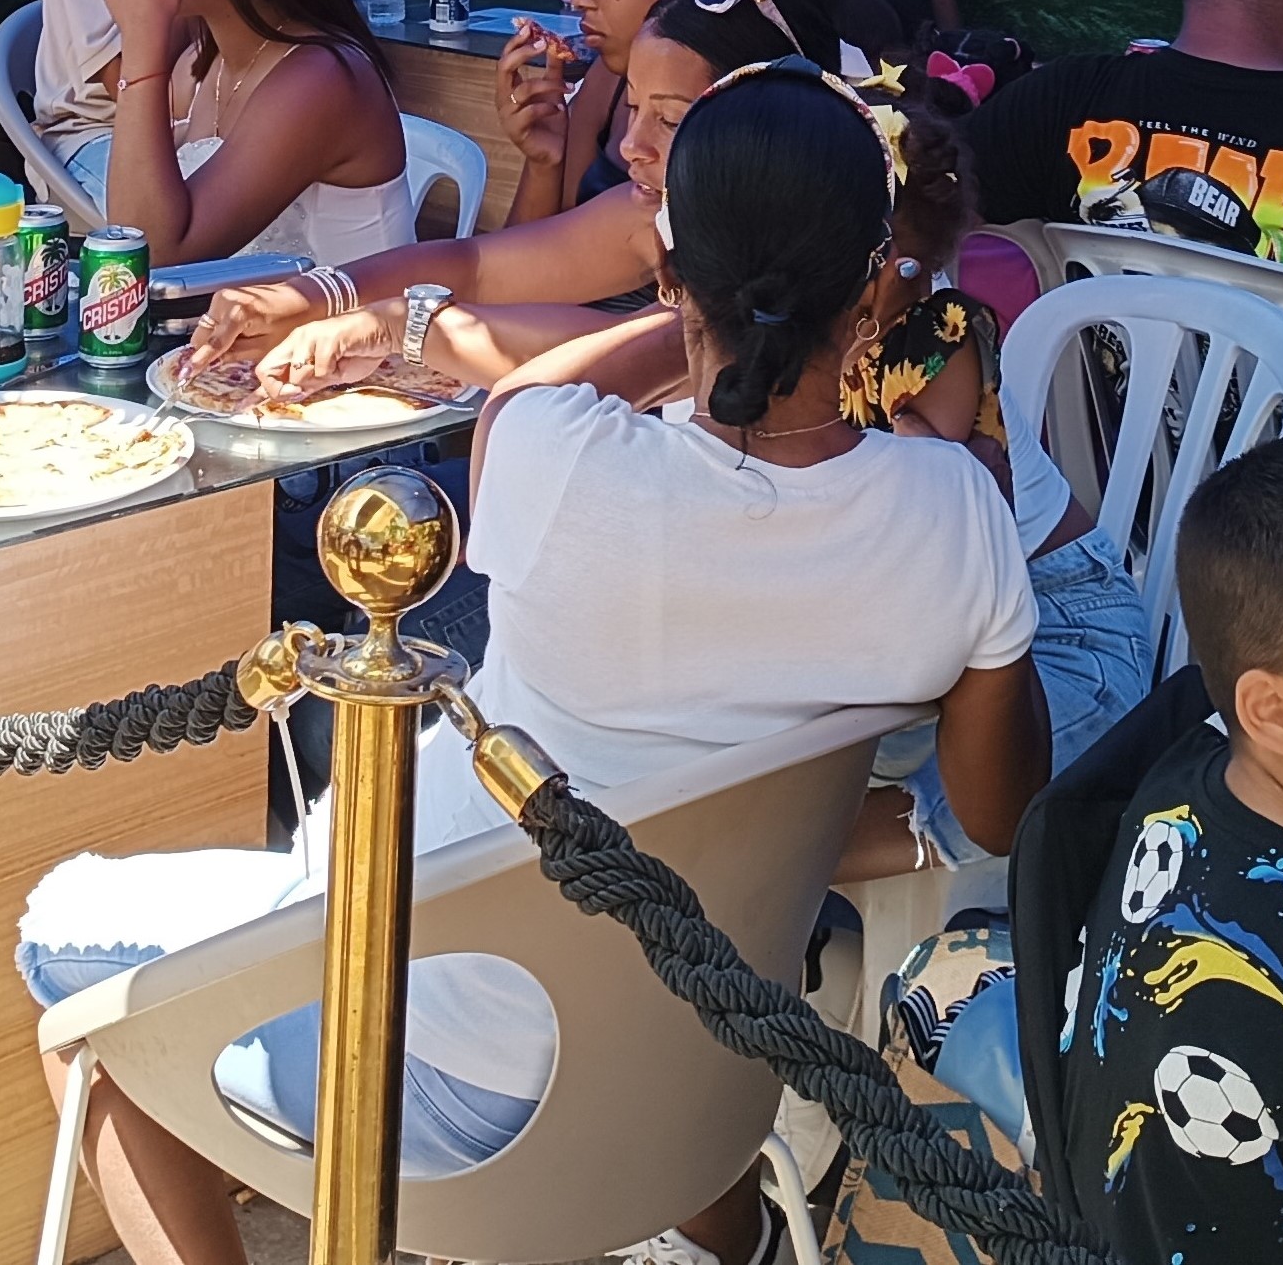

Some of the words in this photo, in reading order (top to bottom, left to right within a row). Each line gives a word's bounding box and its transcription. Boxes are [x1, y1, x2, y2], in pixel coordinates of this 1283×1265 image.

[1139, 119, 1171, 131] FEEL
[1181, 125, 1209, 137] THE
[1218, 132, 1258, 149] WIND
[1188, 176, 1241, 228] BEAR
[82, 286, 146, 331] CRISTAL
